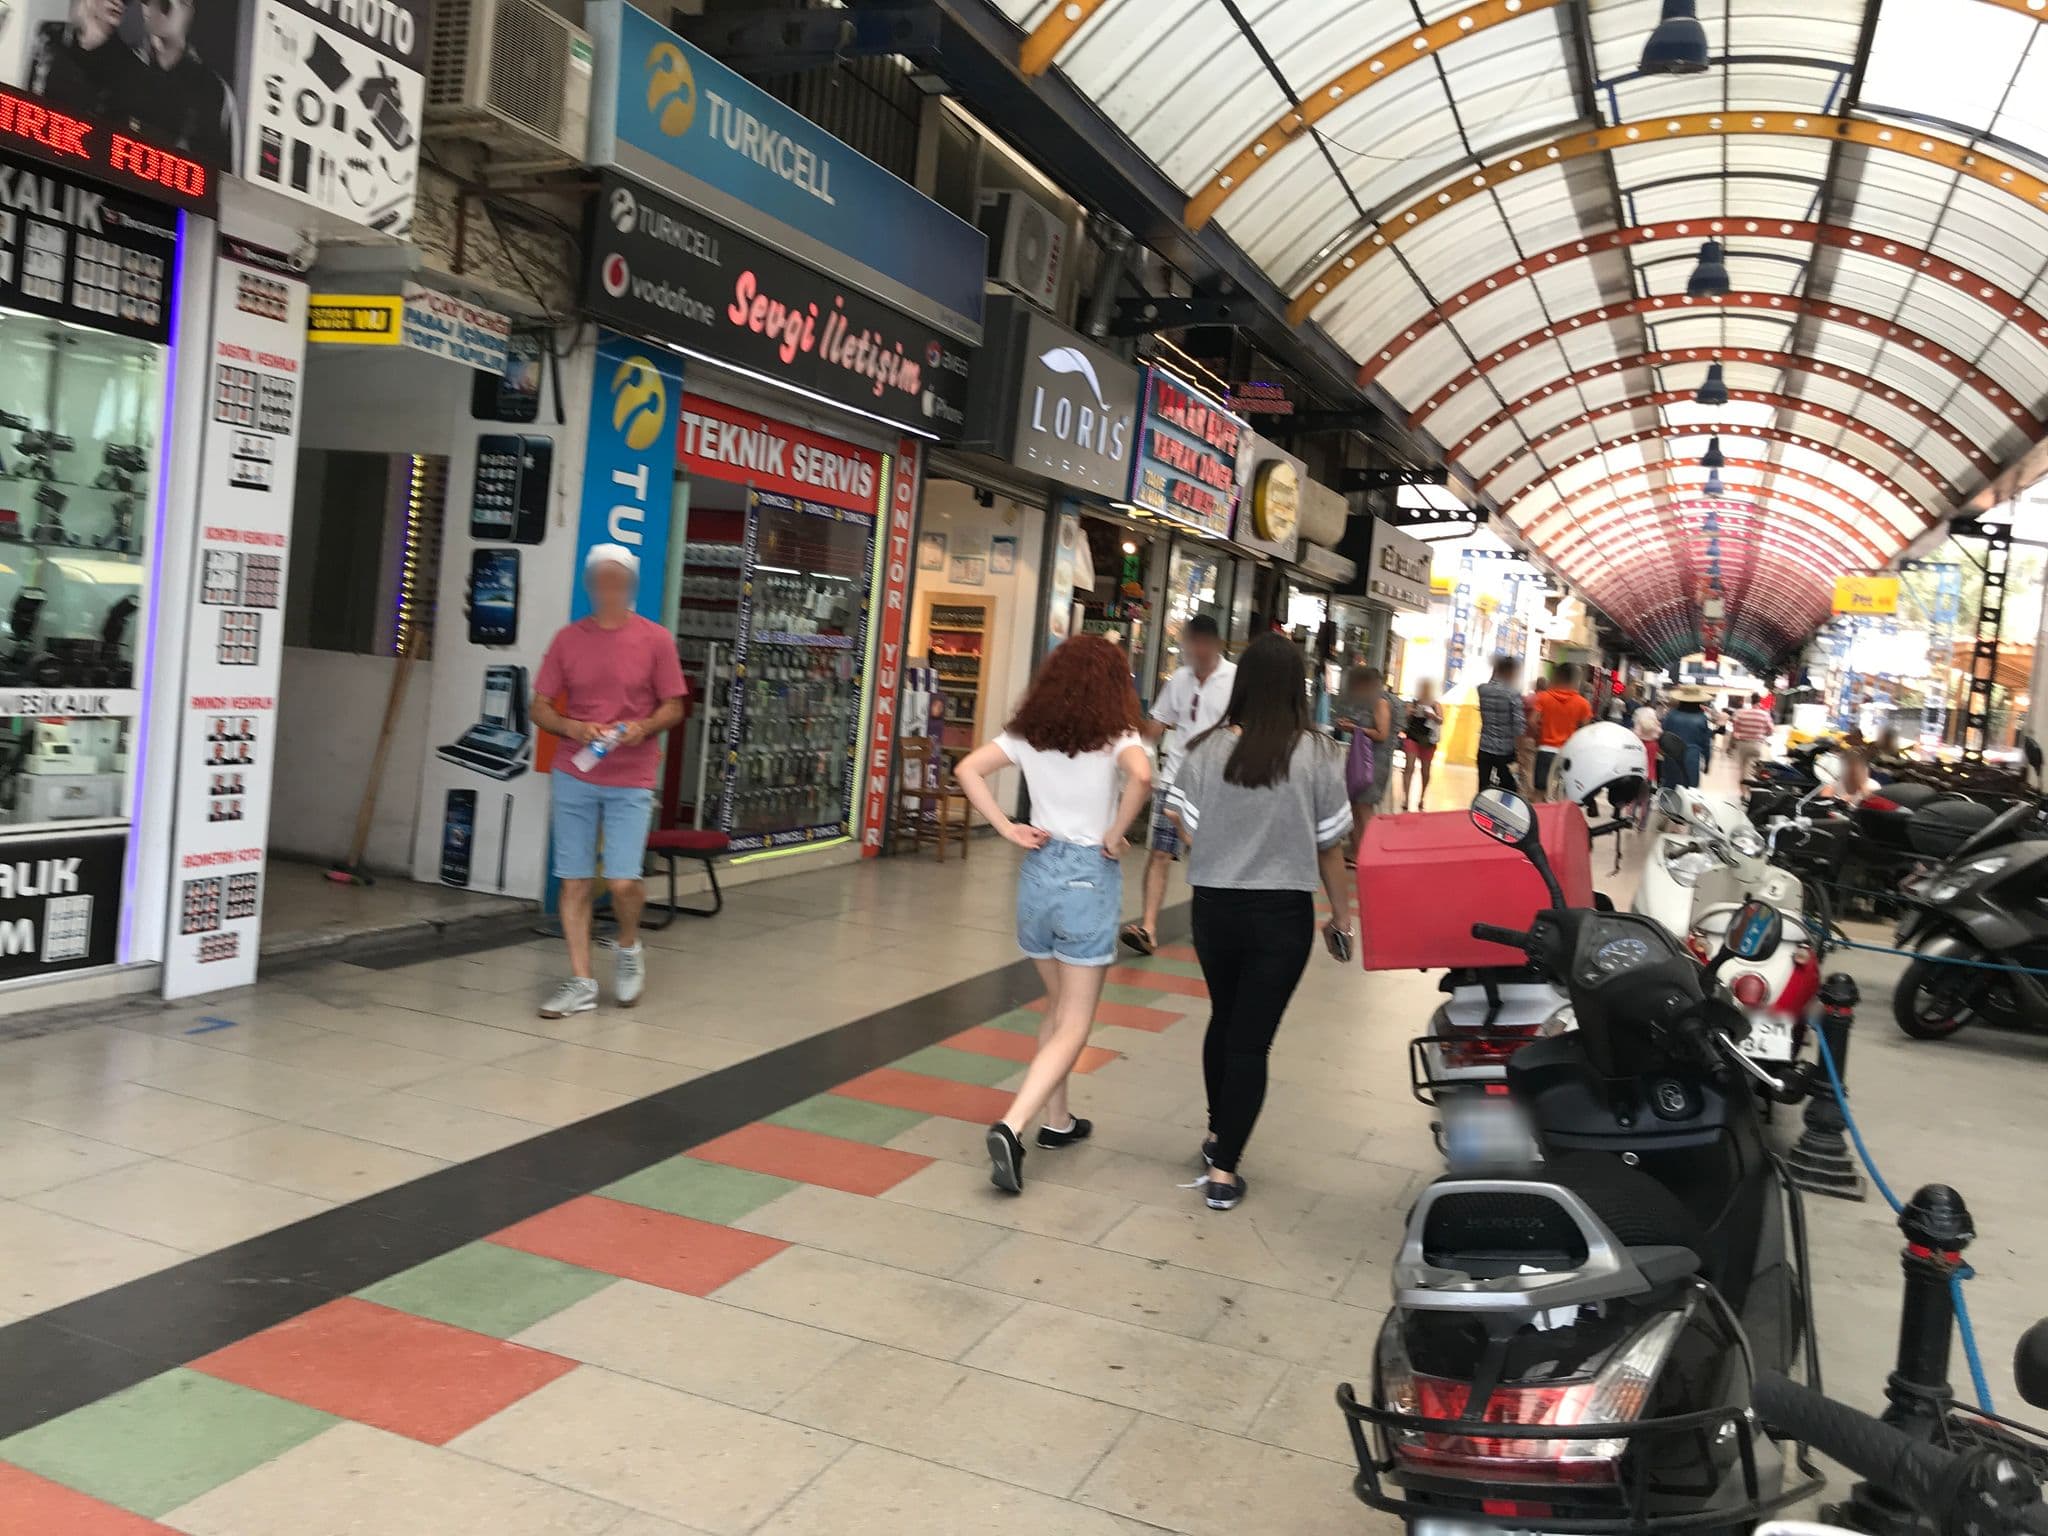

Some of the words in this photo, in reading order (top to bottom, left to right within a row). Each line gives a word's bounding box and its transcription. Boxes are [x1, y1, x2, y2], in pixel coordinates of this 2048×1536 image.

[109, 132, 207, 198] FOTO
[704, 88, 838, 206] TURKCELL
[637, 203, 722, 268] TURKCELL
[631, 274, 716, 328] vodafone
[727, 269, 819, 365] Sevgi
[680, 409, 786, 479] TEKNİK
[791, 442, 874, 500] SERVİS
[607, 463, 651, 555] TU
[864, 642, 899, 849] YÜKLENİR
